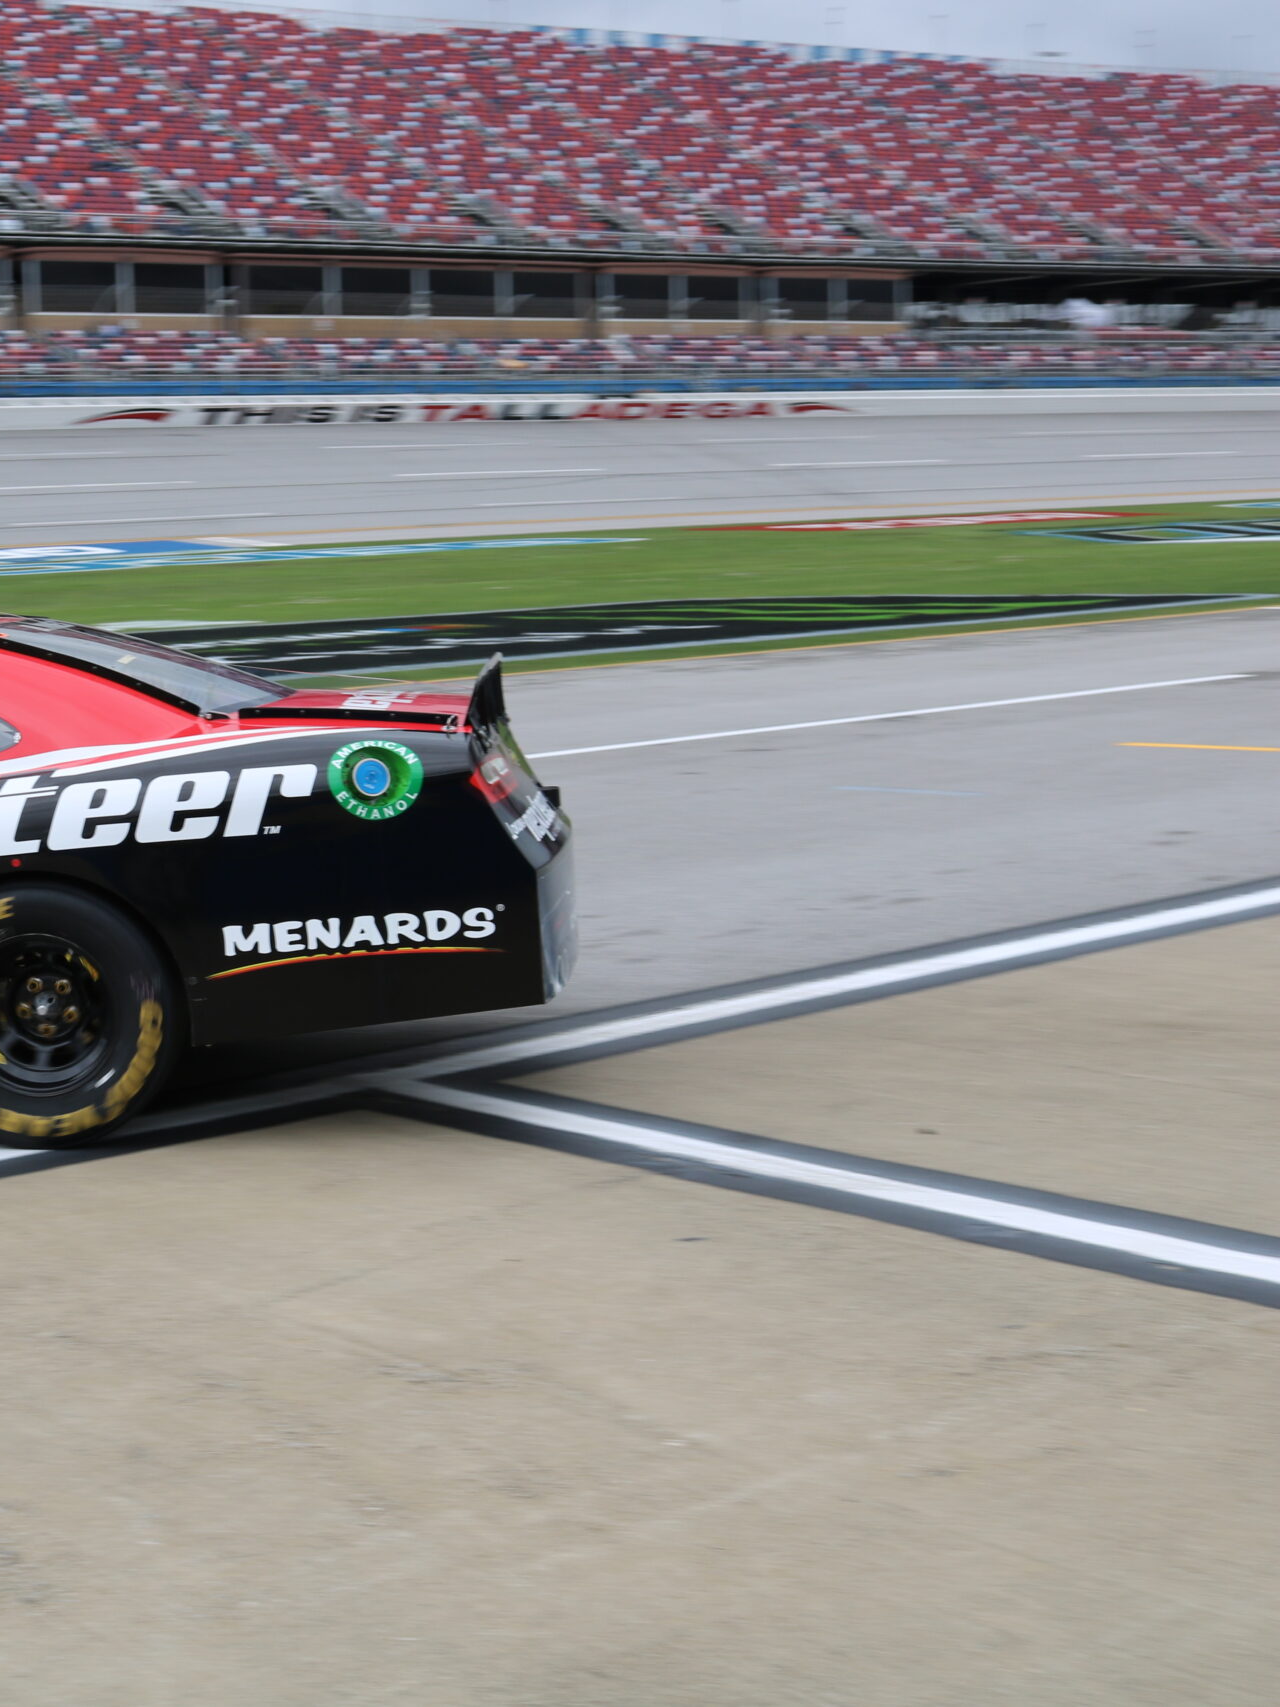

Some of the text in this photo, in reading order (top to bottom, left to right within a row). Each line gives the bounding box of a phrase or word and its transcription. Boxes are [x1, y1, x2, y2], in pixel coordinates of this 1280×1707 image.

[198, 401, 773, 425] THIS IS TALLADEGA
[332, 739, 418, 769] AMERICAN
[336, 790, 418, 819] ETHANOL
[222, 907, 496, 956] MENARDS
